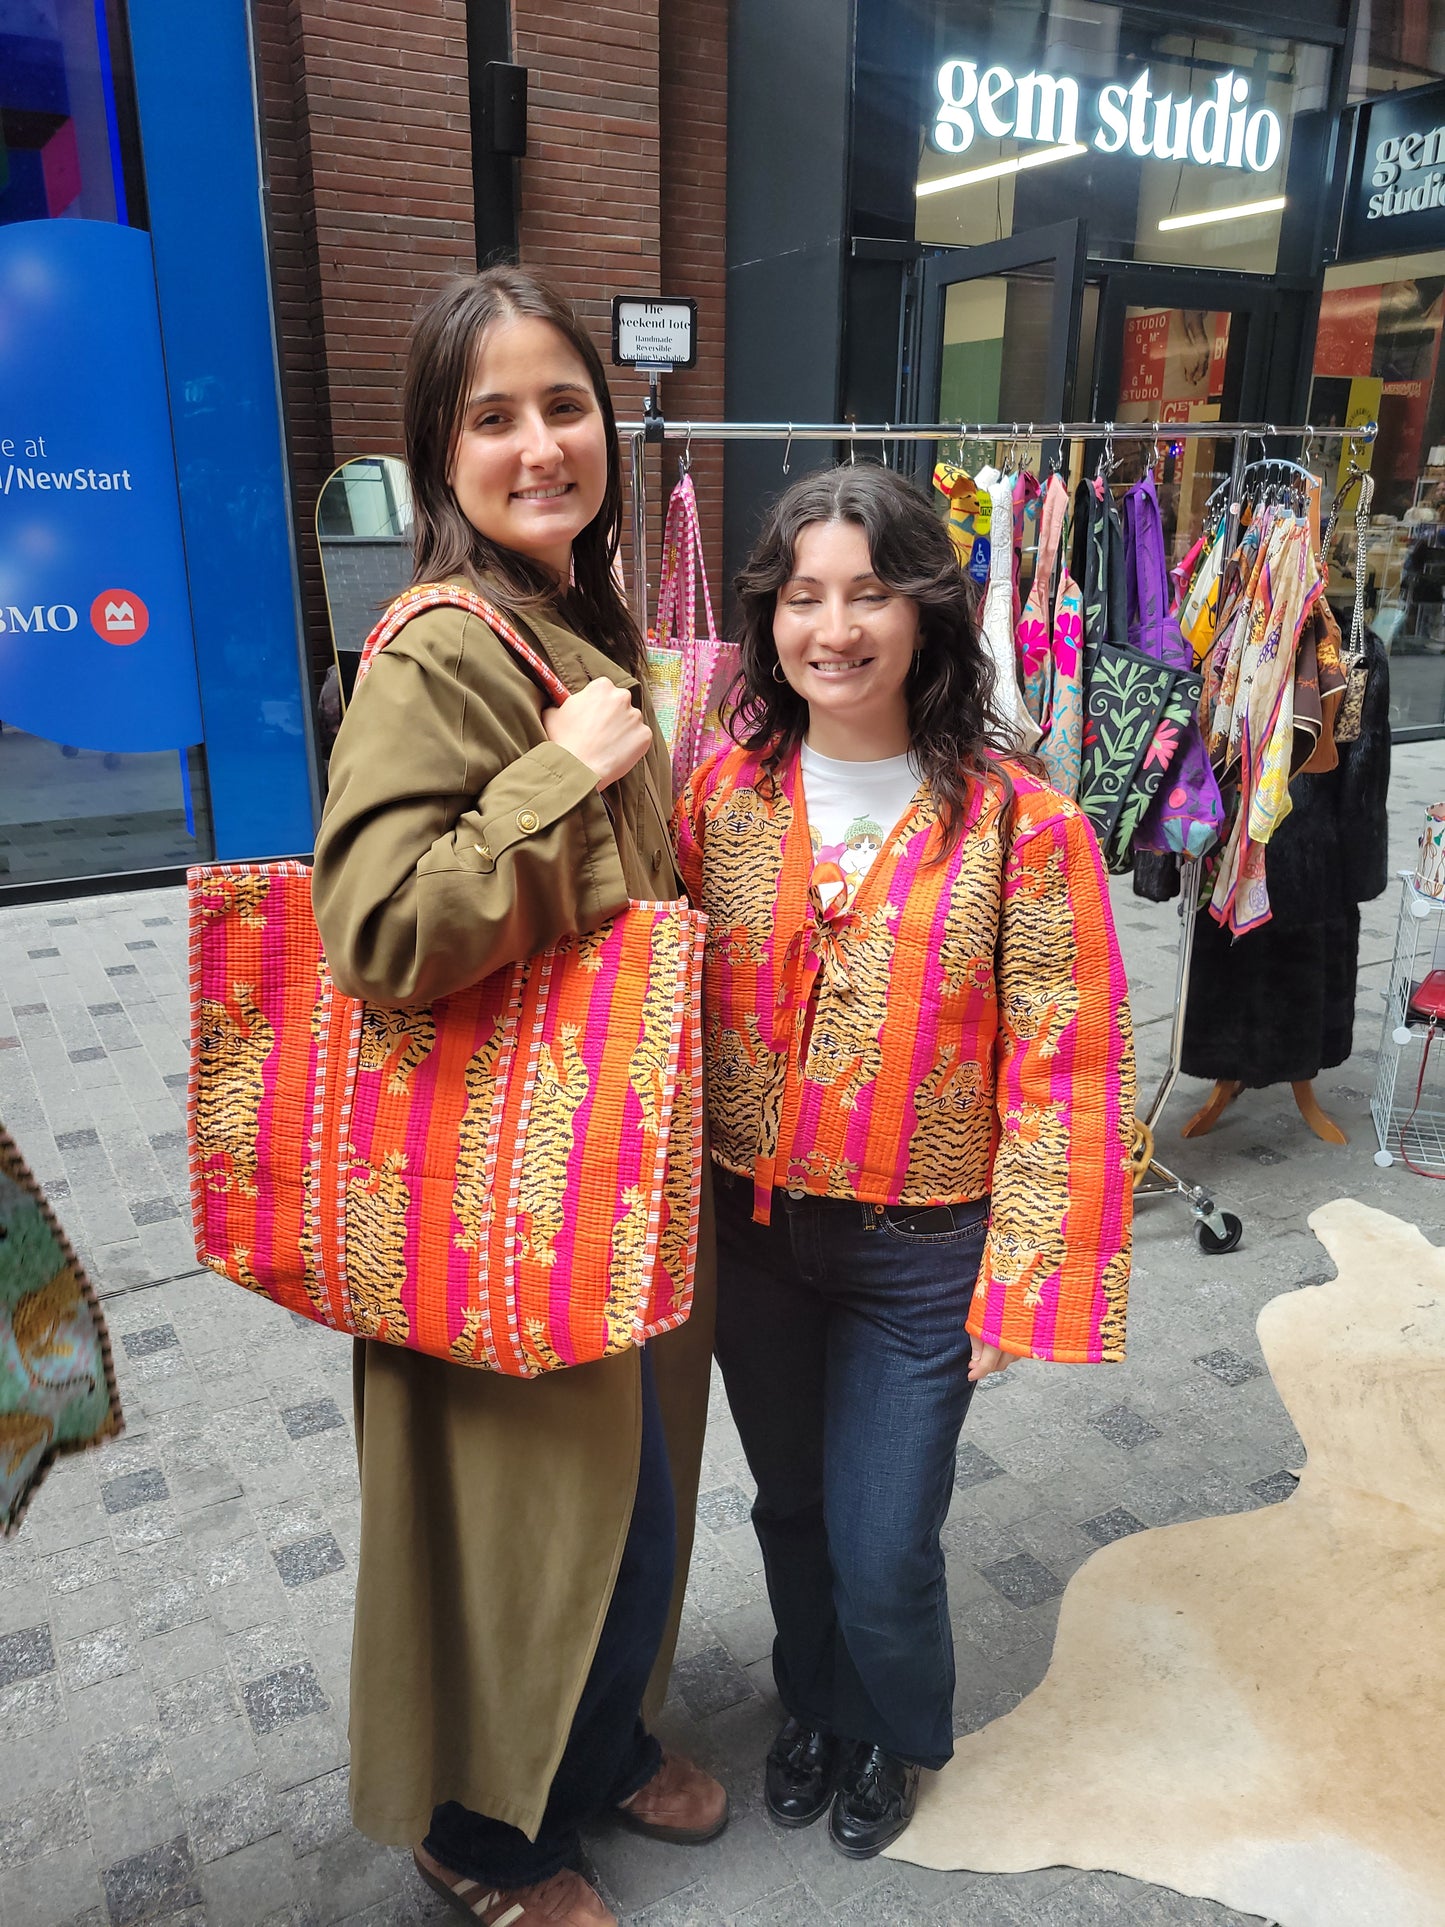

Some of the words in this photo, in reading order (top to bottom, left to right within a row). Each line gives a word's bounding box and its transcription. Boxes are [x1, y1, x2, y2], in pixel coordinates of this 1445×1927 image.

[934, 60, 1080, 153] gem
[1095, 67, 1282, 172] studio
[1128, 315, 1167, 332] STUDIO
[635, 335, 673, 343] Handmade
[636, 344, 672, 352] Reversible
[1122, 387, 1159, 401] STUDIO
[24, 436, 48, 458] at
[0, 464, 133, 495] /NewStart
